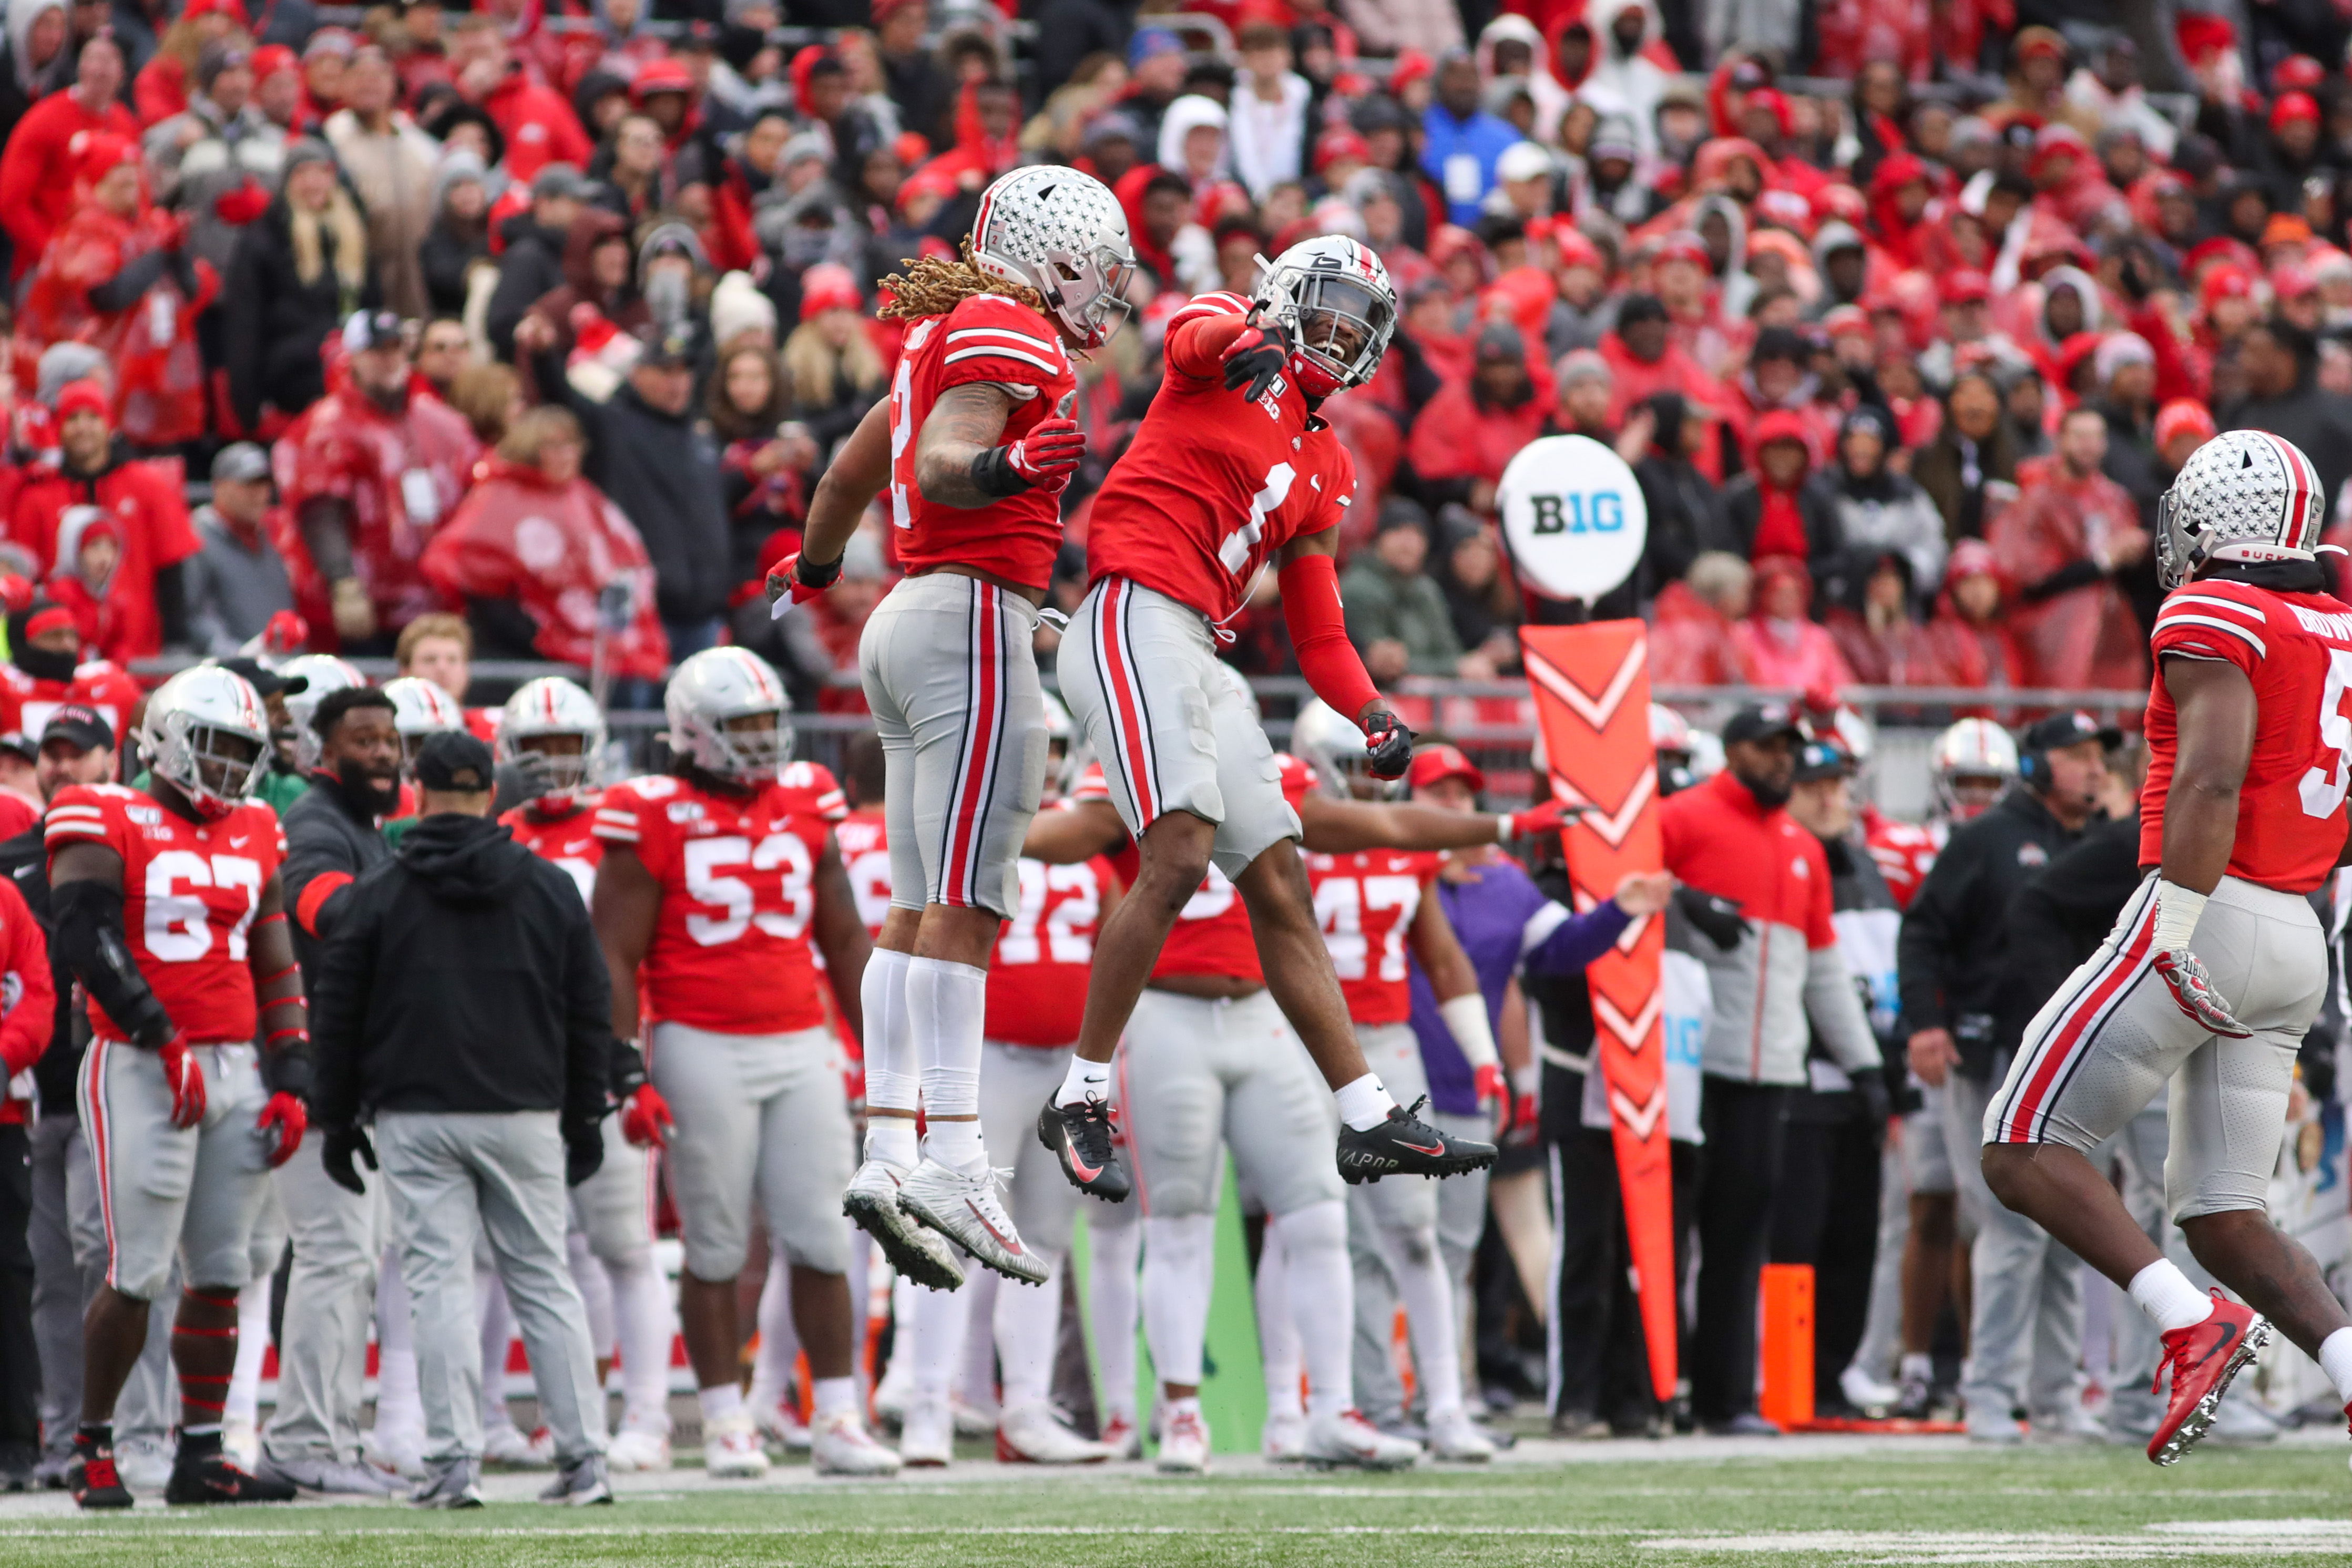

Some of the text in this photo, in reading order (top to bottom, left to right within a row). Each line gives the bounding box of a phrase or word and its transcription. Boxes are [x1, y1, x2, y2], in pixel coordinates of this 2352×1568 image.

[991, 235, 998, 244] 2
[1218, 461, 1297, 575] 1
[2298, 647, 2352, 820] 5
[144, 850, 262, 962] 67
[684, 832, 814, 946] 53
[1314, 875, 1422, 982] 47
